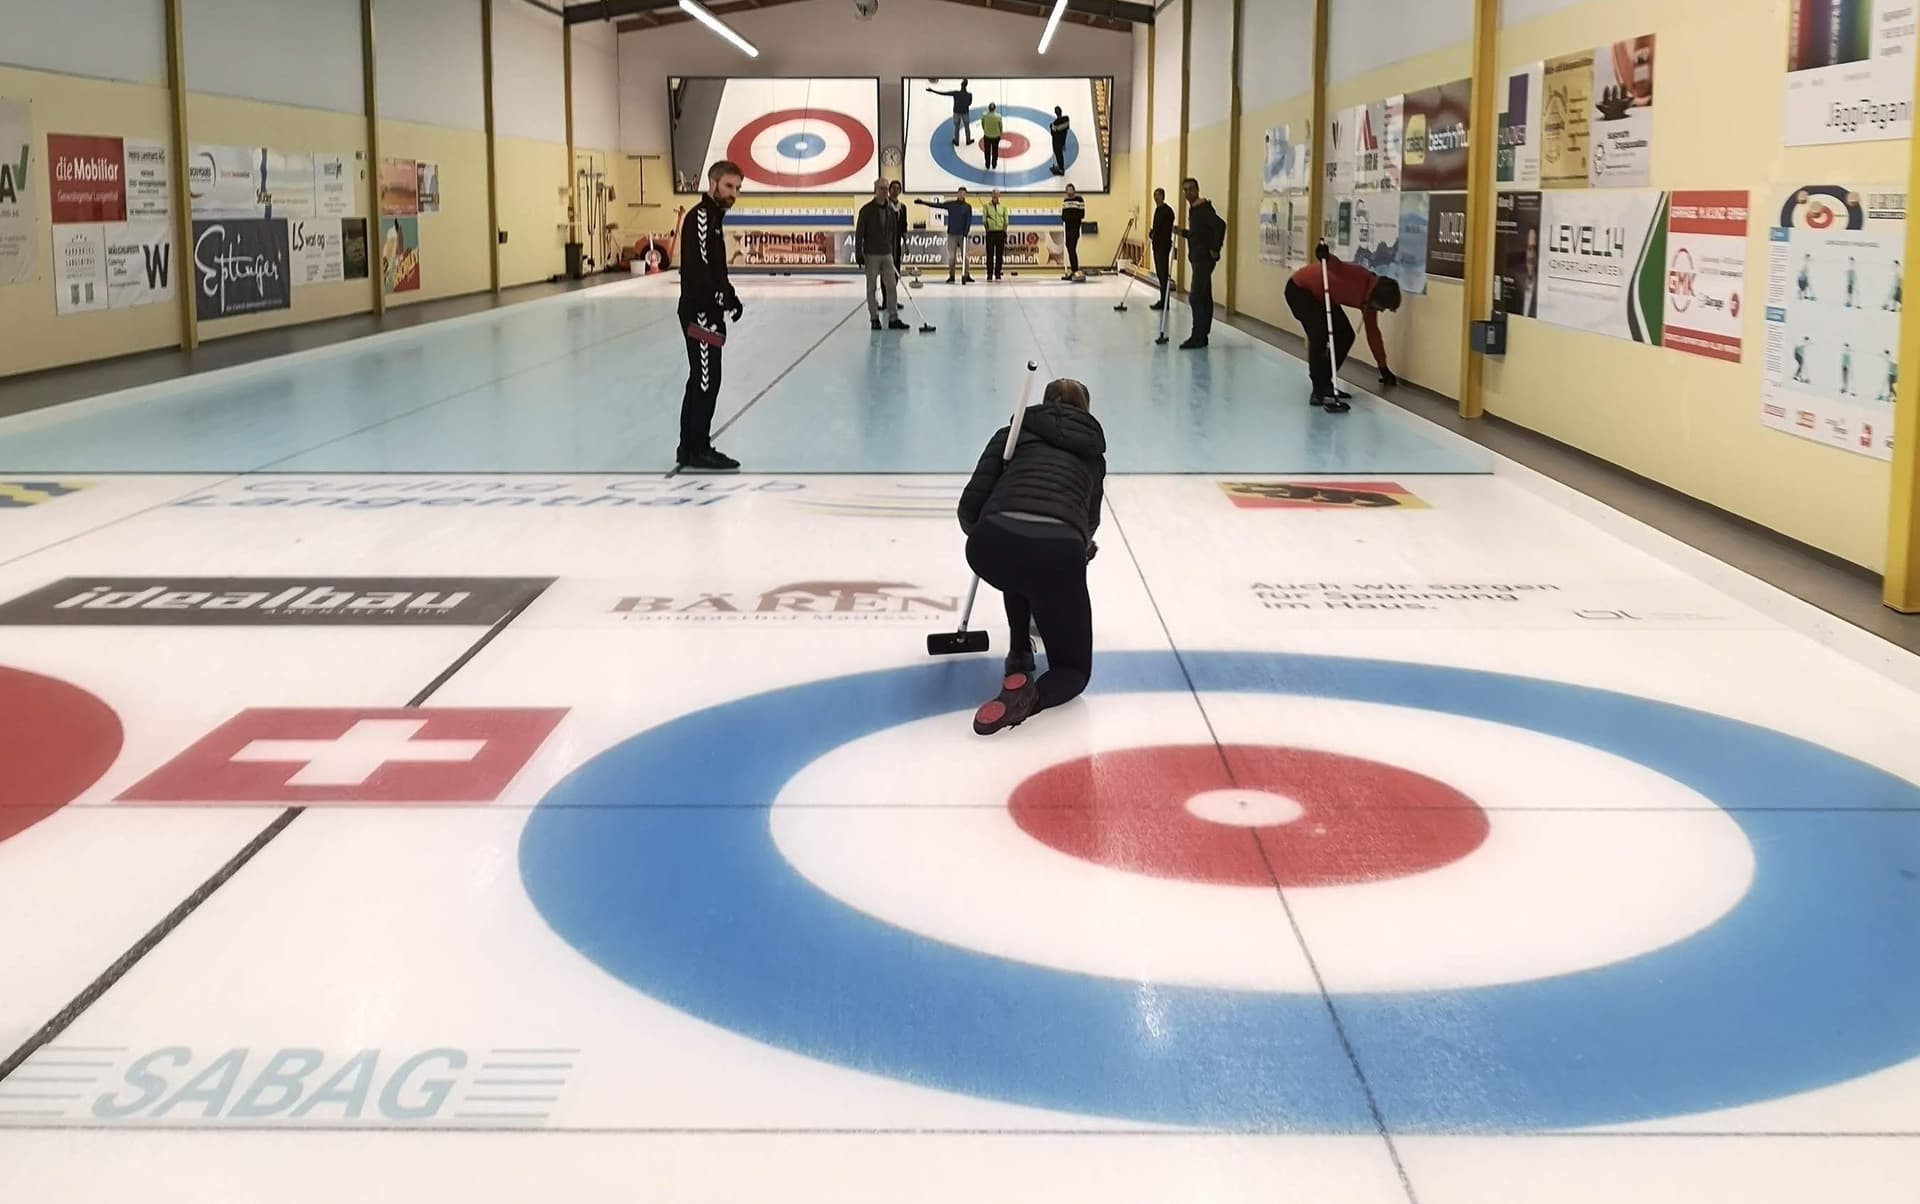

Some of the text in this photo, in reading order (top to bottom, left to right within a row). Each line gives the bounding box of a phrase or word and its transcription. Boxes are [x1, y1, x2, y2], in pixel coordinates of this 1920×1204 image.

[56, 156, 119, 182] die Mobiliar
[292, 221, 305, 252] LS
[744, 231, 813, 247] prometall
[1549, 224, 1625, 258] LEVEL14
[142, 243, 170, 290] W
[194, 224, 283, 313] Eptinger
[746, 254, 761, 264] Tel.
[243, 479, 807, 494] Curling Club
[168, 493, 730, 510] Langenthal
[1250, 581, 1560, 592] Auch wir sorgen
[1255, 591, 1519, 602] für Spannung
[53, 586, 472, 610] idealbau
[604, 592, 962, 613] BÄREN
[1262, 600, 1439, 610] im Haus.
[91, 1045, 468, 1121] SABAG
